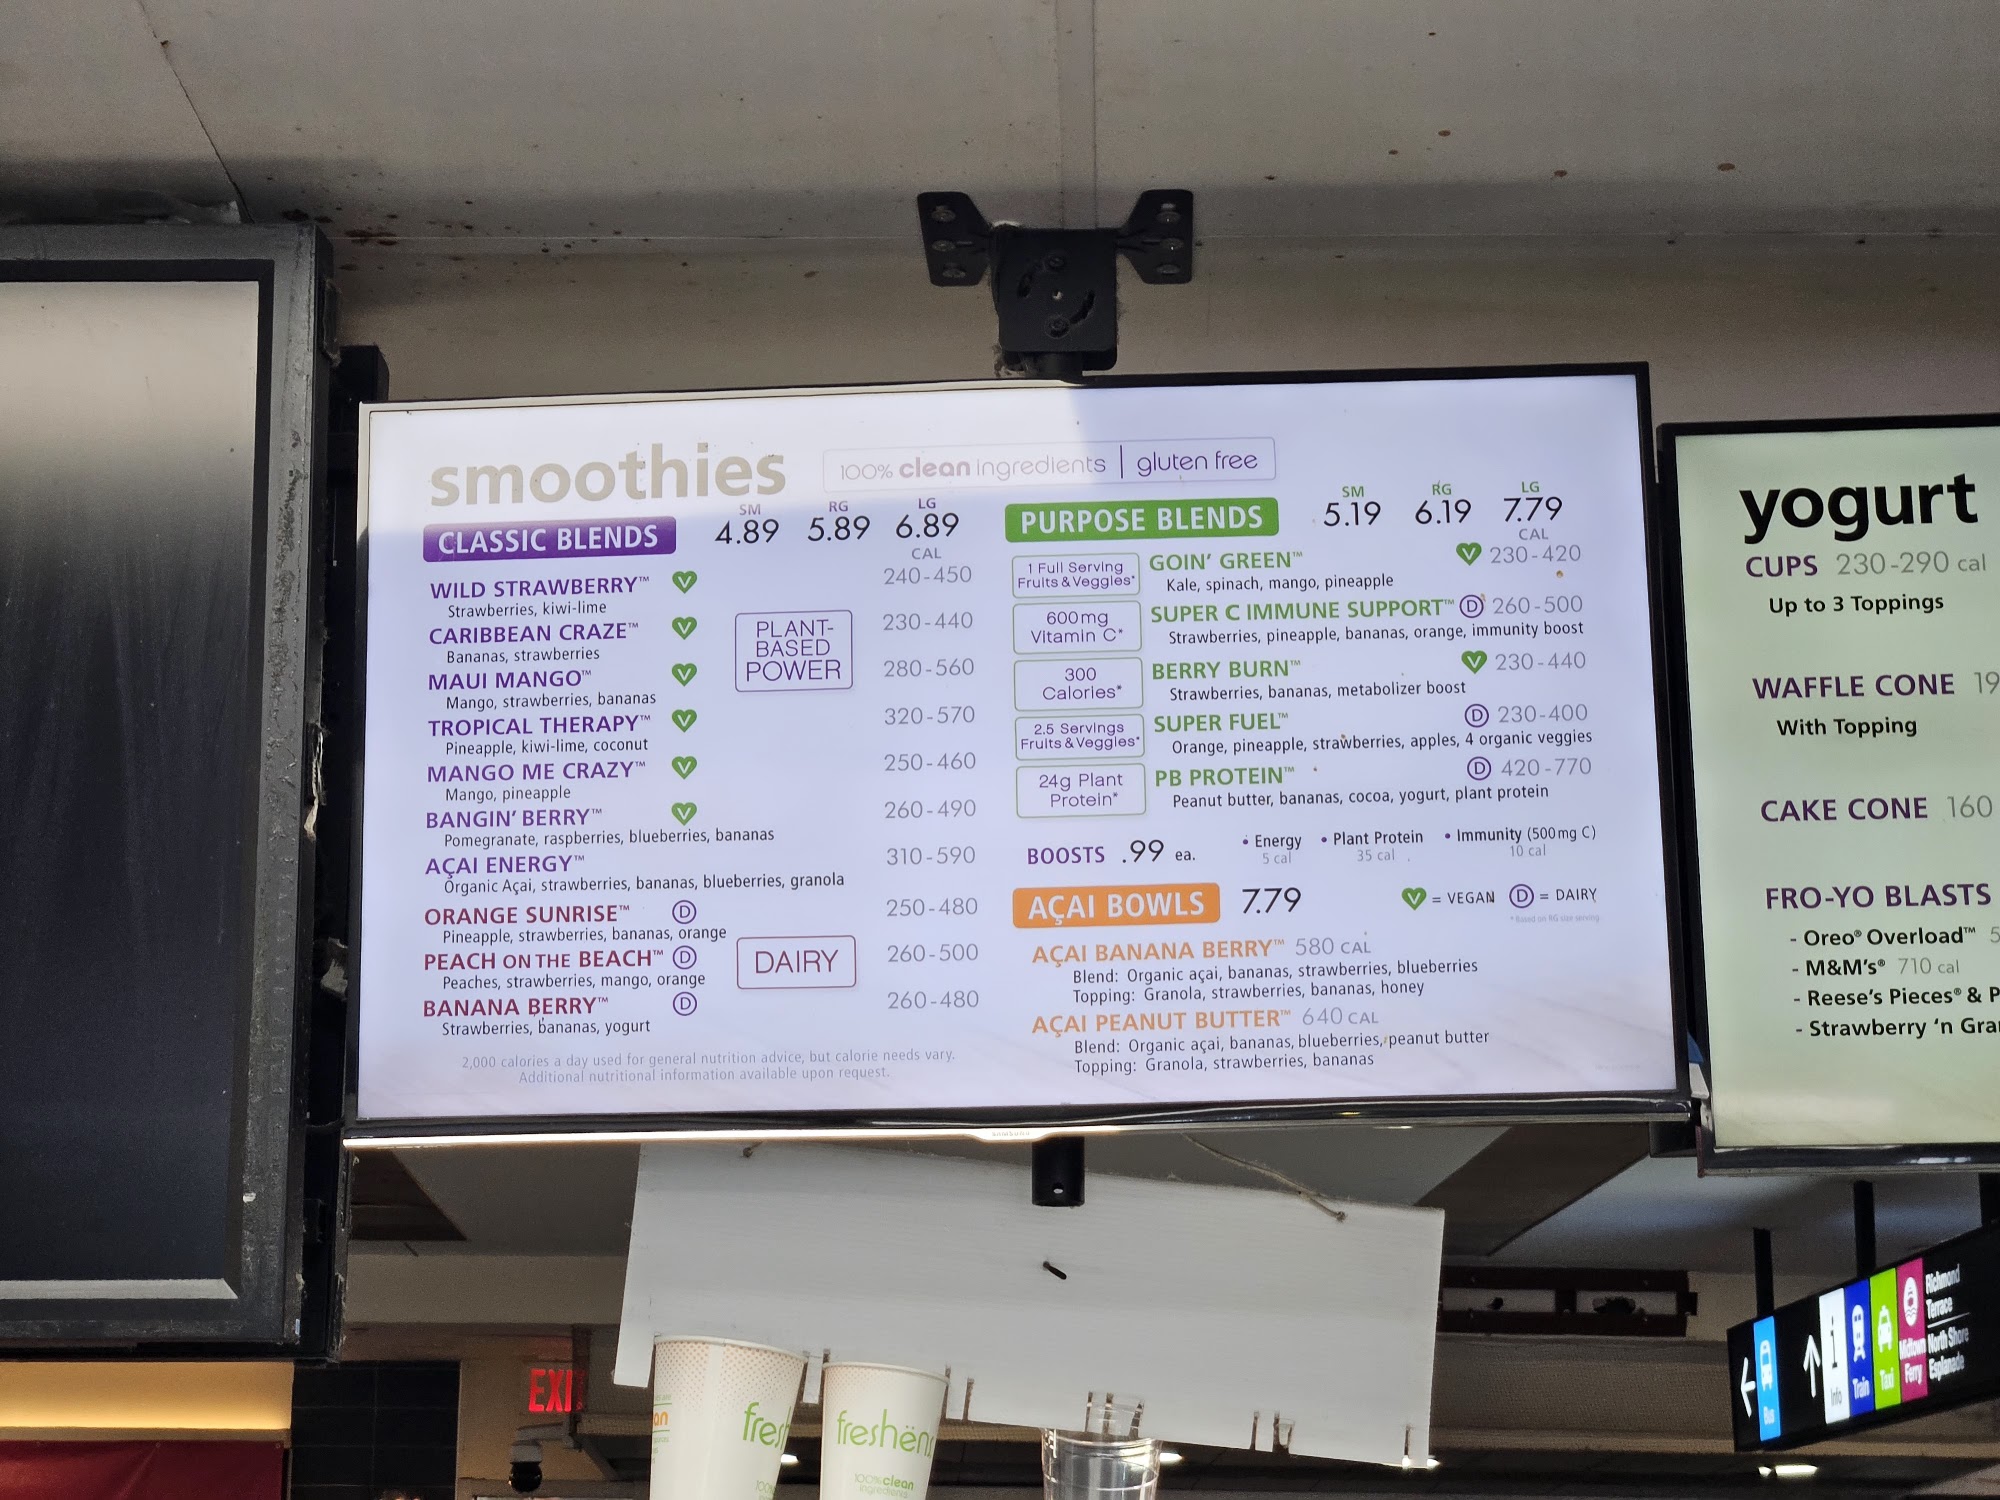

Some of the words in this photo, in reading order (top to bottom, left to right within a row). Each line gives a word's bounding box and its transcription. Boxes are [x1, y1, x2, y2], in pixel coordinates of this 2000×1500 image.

[431, 443, 786, 506] smoothies
[840, 463, 893, 480] 100%
[898, 456, 970, 478] clean
[976, 454, 1106, 481] ingredients
[1137, 451, 1207, 477] gluten
[1215, 450, 1258, 469] free
[1341, 485, 1364, 498] SM
[1432, 479, 1451, 495] RG
[1521, 481, 1539, 493] LG
[739, 503, 760, 516] SM
[828, 500, 848, 512] RG
[918, 497, 936, 509] LG
[1323, 500, 1381, 527] 5.19
[1414, 498, 1471, 524] 6.19
[1503, 496, 1562, 522] 7.79
[1738, 472, 1978, 545] yogurt
[714, 518, 779, 544] 4.89
[807, 515, 870, 542] 5.89
[895, 512, 959, 538] 6.89
[1021, 507, 1145, 534] PURPOSE
[1157, 504, 1263, 530] BLENDS
[438, 527, 546, 554] CLASSIC
[557, 524, 657, 550] BLENDS
[1518, 527, 1548, 540] CAL
[911, 547, 941, 560] CAL
[1745, 554, 1817, 578] CUPS
[1957, 553, 1986, 572] cal
[430, 581, 485, 599] WILD
[1166, 577, 1200, 593] Kale,
[1205, 575, 1262, 594] spinach,
[1268, 577, 1319, 592] mango,
[1324, 572, 1393, 591] pineapple
[448, 602, 537, 618] Strawberries,
[542, 600, 606, 615] kiwi-lime
[1769, 597, 1797, 617] Up
[1803, 597, 1825, 612] to
[1833, 595, 1844, 612] 3
[1849, 593, 1944, 615] Toppings
[429, 624, 550, 644] CARIBBEAN
[756, 618, 834, 638] PLANT-
[446, 650, 508, 664] Bananas,
[514, 646, 600, 662] strawberries
[756, 638, 830, 657] BASED
[746, 658, 840, 682] POWER
[1751, 675, 1864, 699] WAFFLE
[1875, 673, 1955, 696] CONE
[446, 696, 497, 712] Mango,
[502, 692, 592, 708] strawberries,
[597, 691, 656, 705] bananas
[1154, 714, 1222, 732] SUPER
[1776, 717, 1826, 736] With
[1832, 716, 1917, 738] Topping
[446, 739, 516, 758] Pineapple,
[521, 738, 587, 753] kiwi-lime,
[593, 738, 648, 751] coconut
[1760, 798, 1837, 822] CAKE
[1847, 796, 1928, 820] CONE
[1947, 794, 1992, 818] 160
[444, 833, 538, 850] Pomegranate,
[544, 830, 623, 848] raspberries,
[629, 828, 709, 844] blueberries,
[715, 827, 774, 841] bananas
[1254, 834, 1302, 850] Energy
[1333, 830, 1369, 845] Plant
[1374, 829, 1423, 844] Protein
[1457, 826, 1522, 844] Immunity
[1027, 845, 1105, 864] BOOSTS
[1122, 839, 1164, 863] .99
[1175, 850, 1195, 861] ea.
[1028, 893, 1095, 925] AÇAI
[1107, 890, 1204, 918] BOWLS
[1241, 886, 1301, 914] 7.79
[1447, 890, 1495, 904] VEGAN
[1555, 887, 1597, 903] DAIRY
[1765, 885, 1874, 909] FRO-YO
[1885, 882, 1991, 907] BLASTS
[424, 952, 495, 970] PEACH
[502, 954, 530, 969] ON
[534, 953, 570, 968] THE
[755, 949, 838, 974] DAIRY
[1031, 944, 1086, 968] AÇAI
[1095, 941, 1194, 962] BANANA
[1295, 937, 1334, 956] 580
[1340, 940, 1371, 954] CAL
[1073, 968, 1118, 984] Blend:
[1127, 966, 1183, 985] Organic
[1188, 965, 1222, 984] açai,
[1228, 964, 1292, 979] bananas,
[1298, 960, 1391, 977] strawberries,
[1397, 958, 1478, 974] blueberries
[1898, 957, 1931, 974] 710
[1937, 958, 1959, 974] cal
[443, 974, 500, 990] Peaches,
[506, 973, 595, 988] strawberries,
[601, 975, 651, 990] mango,
[656, 974, 705, 989] orange
[1966, 986, 1982, 1003] &
[442, 1020, 532, 1036] Strawberries,
[538, 1016, 599, 1034] bananas,
[604, 1019, 650, 1036] yogurt
[1809, 1018, 1926, 1039] Strawberry
[518, 1069, 583, 1083] Additional
[589, 1068, 655, 1082] nutritional
[660, 1067, 734, 1080] information
[739, 1066, 796, 1080] available
[801, 1069, 833, 1082] upon
[839, 1066, 889, 1080] request.
[1926, 1263, 1960, 1294] Richmond
[1926, 1296, 1953, 1320] Terrace
[1899, 1338, 1927, 1360] Midtown
[1928, 1330, 1948, 1354] North
[1948, 1326, 1970, 1348] Shore
[1904, 1363, 1923, 1385] Ferry
[1928, 1350, 1965, 1382] Esplanade
[1852, 1376, 1870, 1400] Train
[1880, 1367, 1894, 1391] Taxi
[1830, 1388, 1843, 1407] Info
[1763, 1406, 1775, 1426] Bus
[882, 1474, 914, 1490] clean
